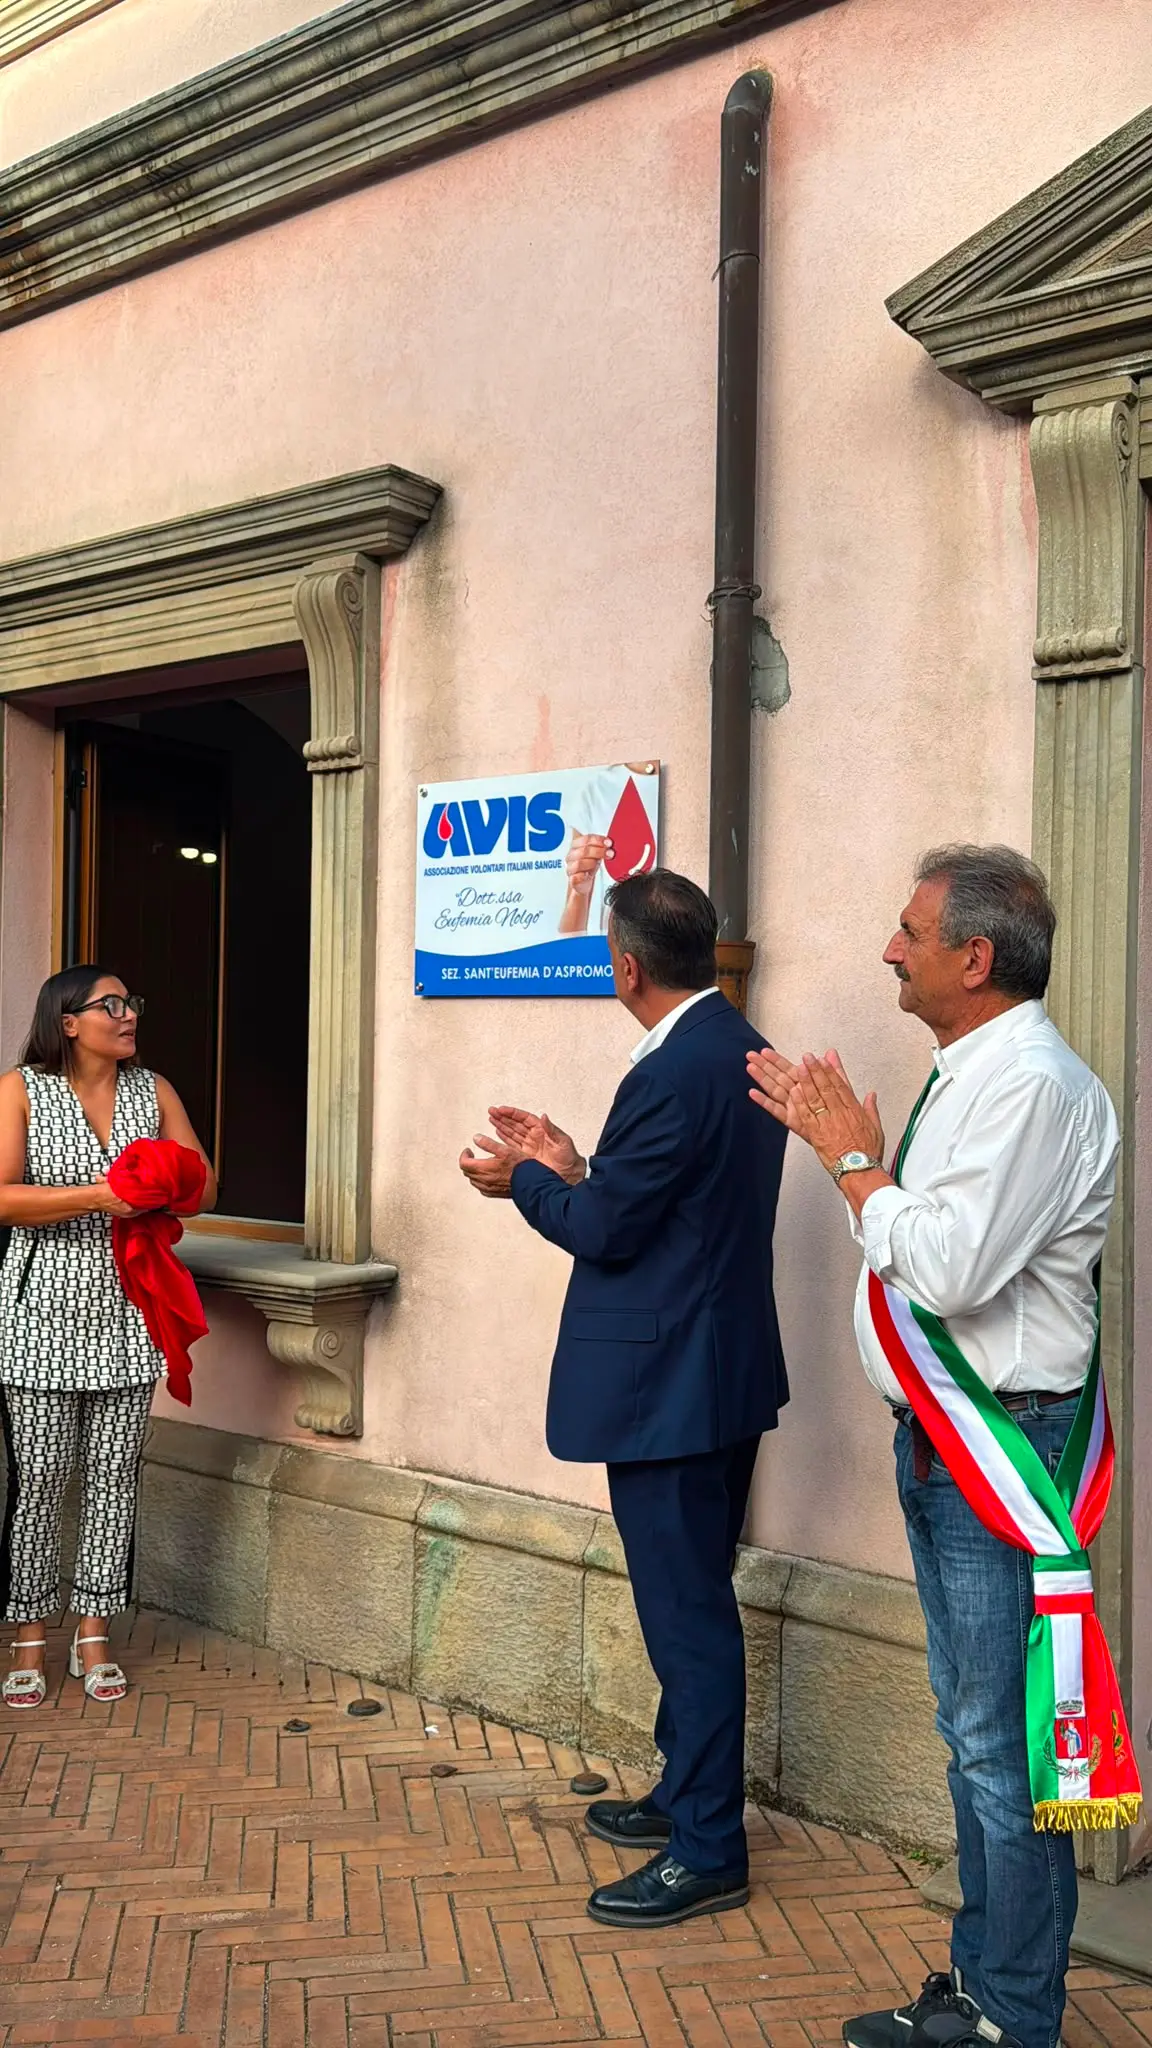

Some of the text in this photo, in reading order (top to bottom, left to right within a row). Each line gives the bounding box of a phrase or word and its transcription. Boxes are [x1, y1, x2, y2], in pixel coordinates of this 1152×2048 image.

[423, 792, 566, 859] AVIS
[424, 859, 562, 876] ASSOCIAZIONE VOLONTARI ITALIANI SANGUE
[434, 908, 493, 932] Eufemia
[441, 963, 614, 980] SEZ. SANT'EUFEMIA D'ASPROMO
